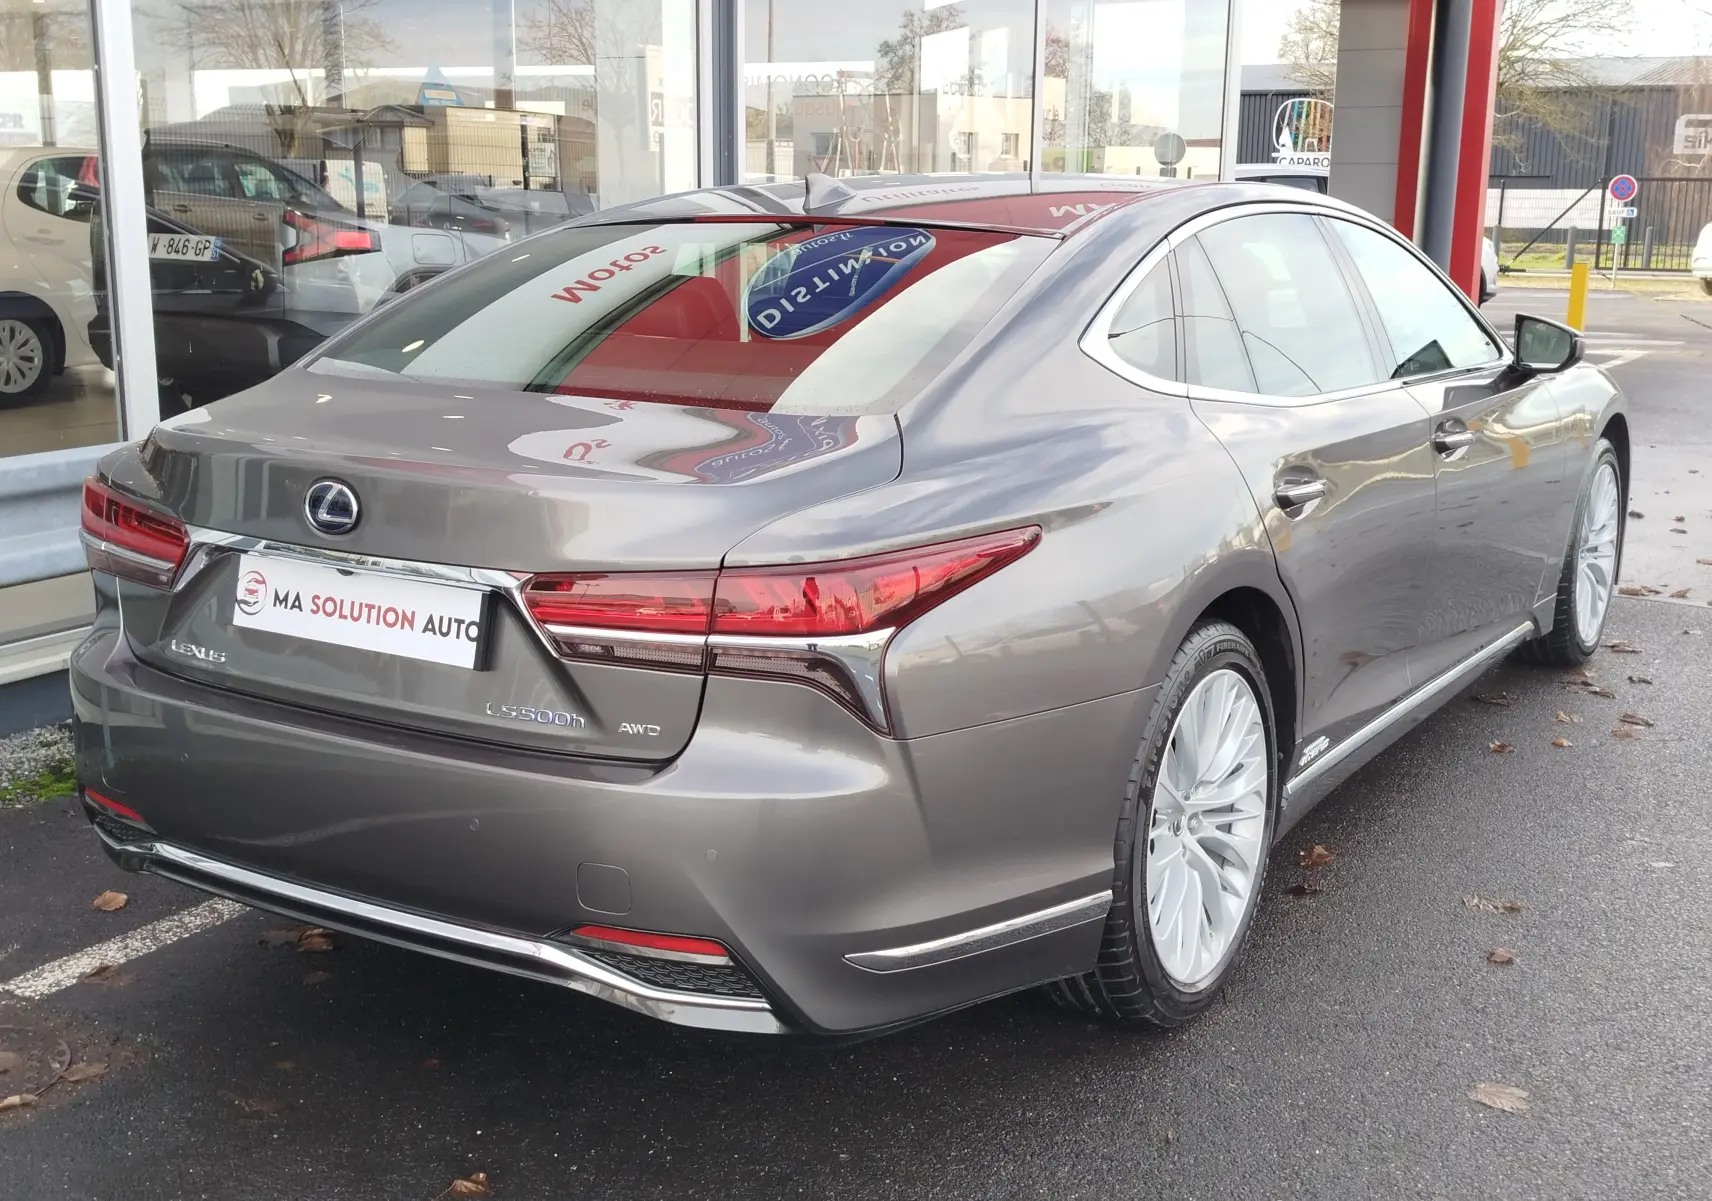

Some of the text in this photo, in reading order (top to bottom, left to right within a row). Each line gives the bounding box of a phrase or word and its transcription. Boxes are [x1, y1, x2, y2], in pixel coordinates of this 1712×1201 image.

[273, 588, 481, 643] MA SOLUTION AUTO
[171, 639, 226, 662] LEXUS
[618, 722, 661, 736] AWD
